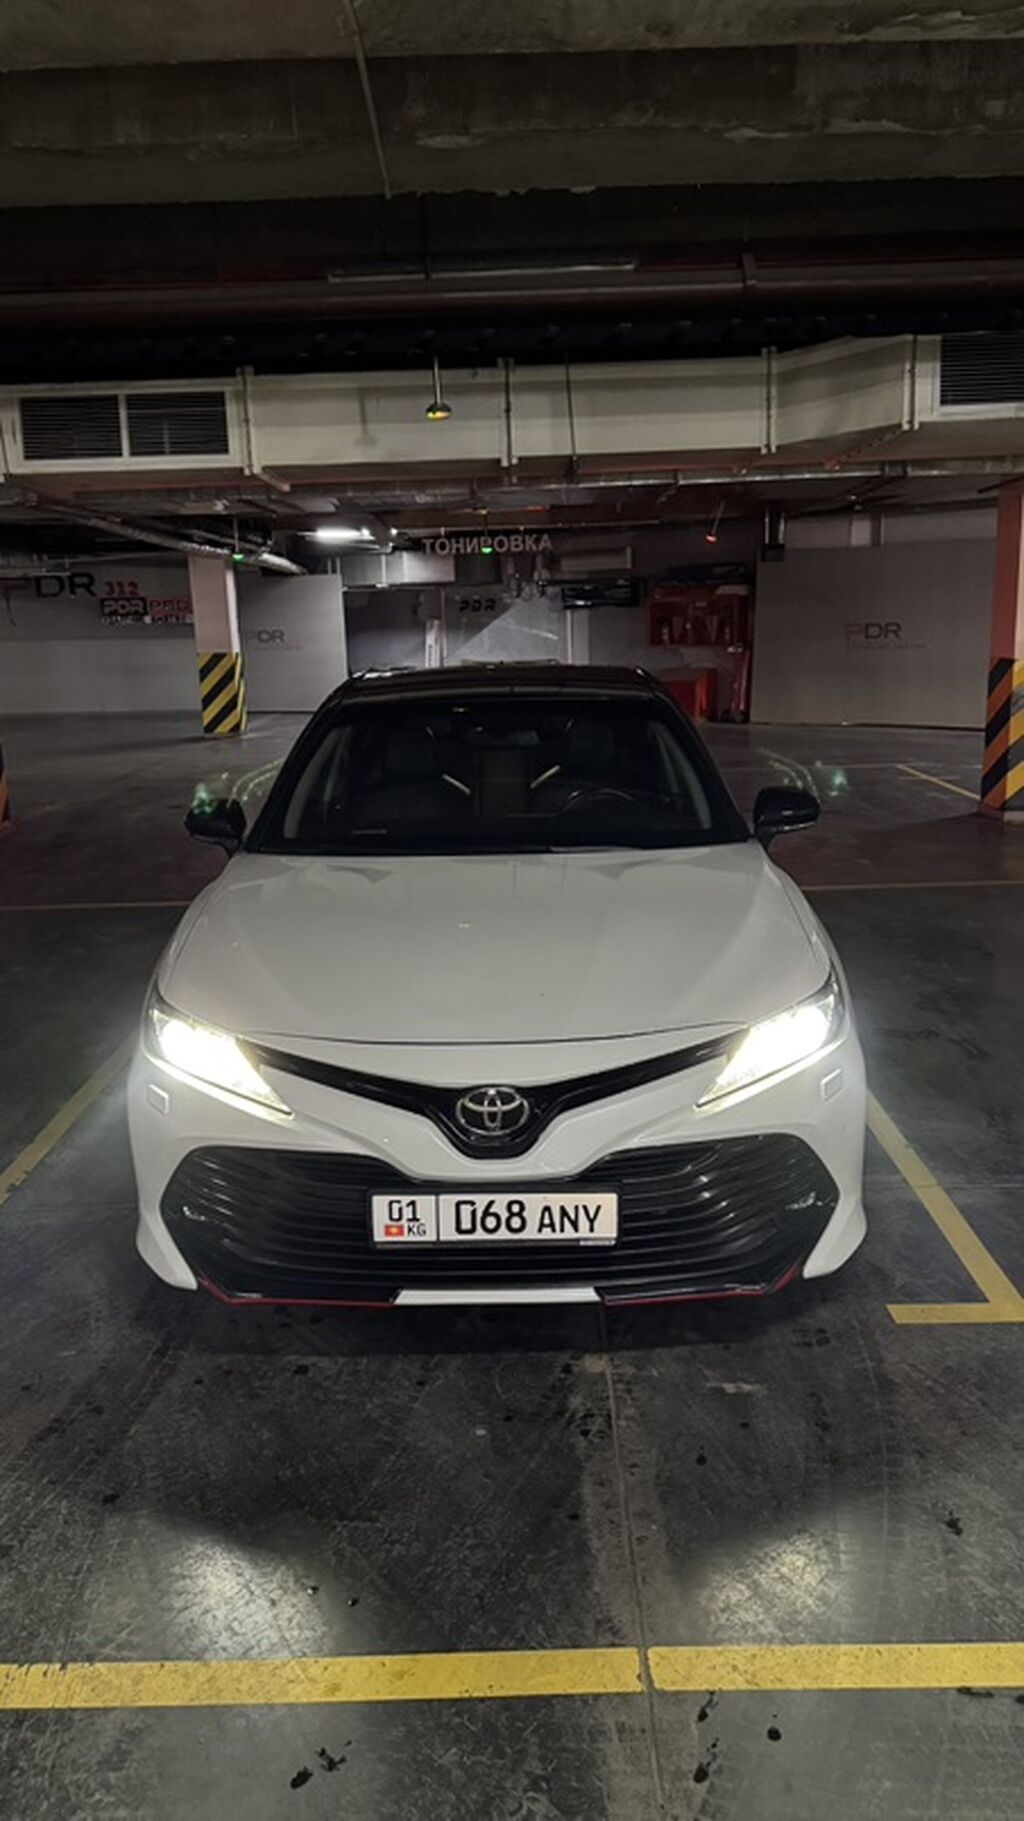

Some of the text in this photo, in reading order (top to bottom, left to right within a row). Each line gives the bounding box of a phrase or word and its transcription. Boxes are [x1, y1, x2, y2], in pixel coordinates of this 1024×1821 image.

[422, 533, 554, 554] ТОНИРОВКА
[459, 598, 496, 613] PDR
[387, 1199, 421, 1223] 01
[454, 1199, 602, 1235] 068 ANY
[406, 1223, 427, 1237] KG
